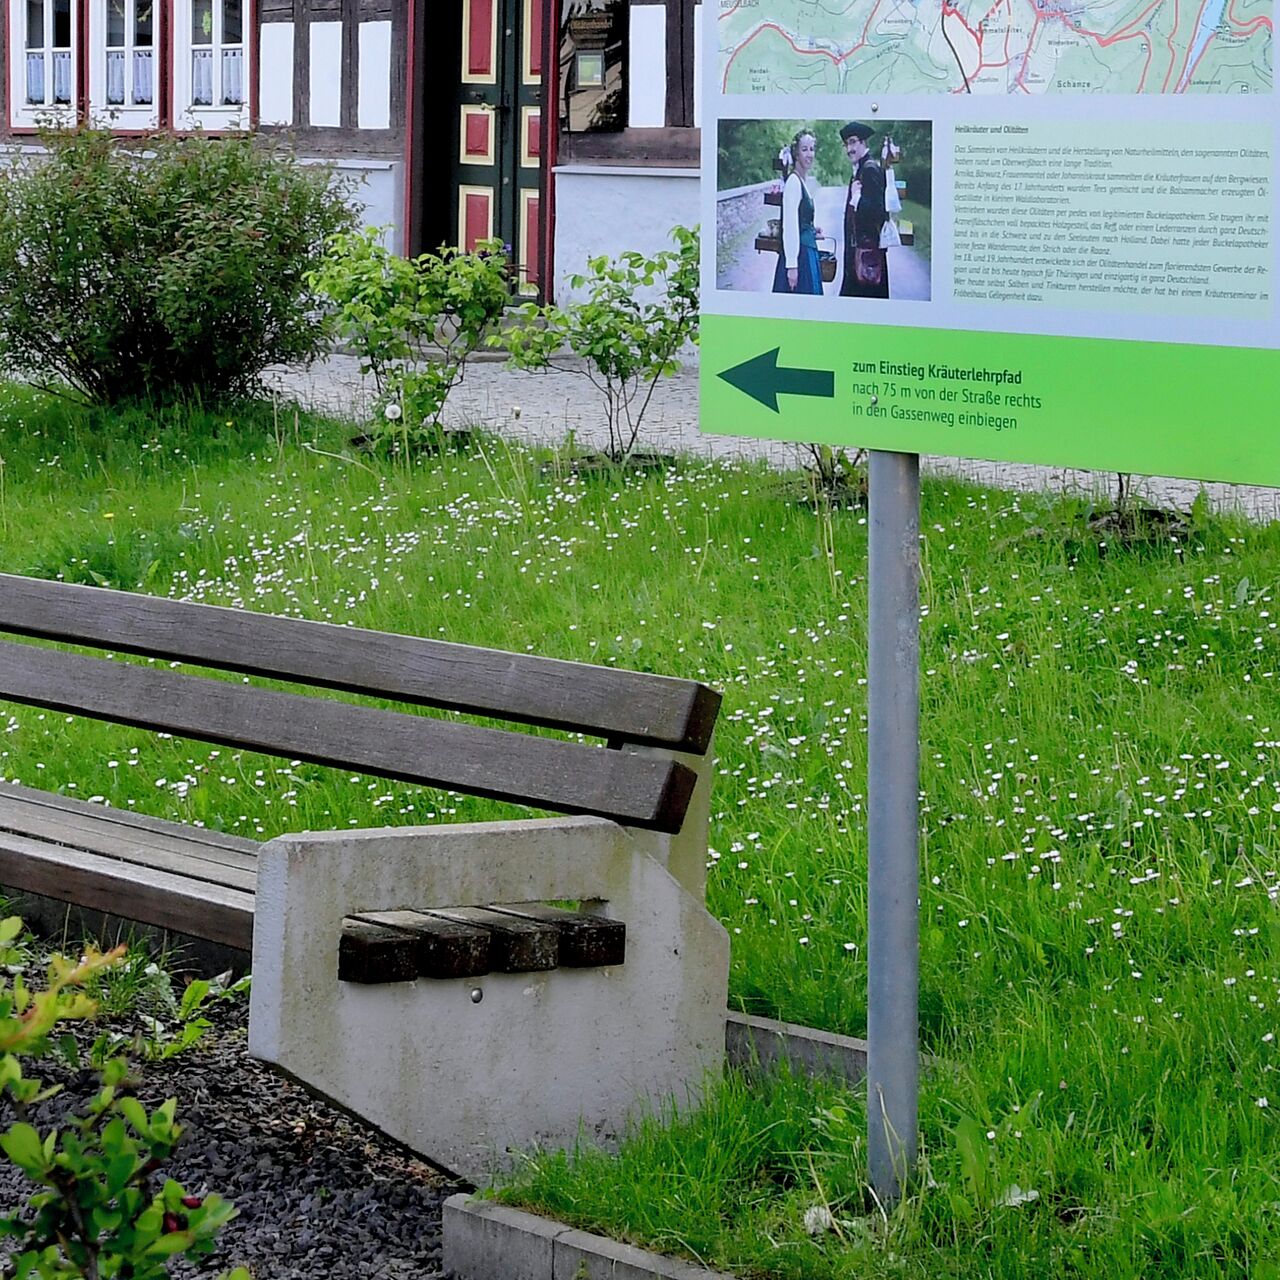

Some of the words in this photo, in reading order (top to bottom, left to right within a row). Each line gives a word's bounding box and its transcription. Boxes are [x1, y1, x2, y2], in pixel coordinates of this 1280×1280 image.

[852, 361, 877, 374] zum
[879, 360, 925, 381] Einstieg
[928, 363, 1022, 387] Kräuterlehrpfad
[852, 381, 879, 396] nach
[882, 382, 897, 398] 75
[900, 387, 912, 398] m
[914, 388, 936, 400] von
[938, 387, 959, 402] der
[961, 388, 1001, 406] Straße
[1004, 393, 1042, 409] rechts
[852, 401, 863, 416] in
[865, 400, 888, 418] den
[890, 404, 955, 428] Gassenweg
[958, 410, 1018, 432] einbiegen
